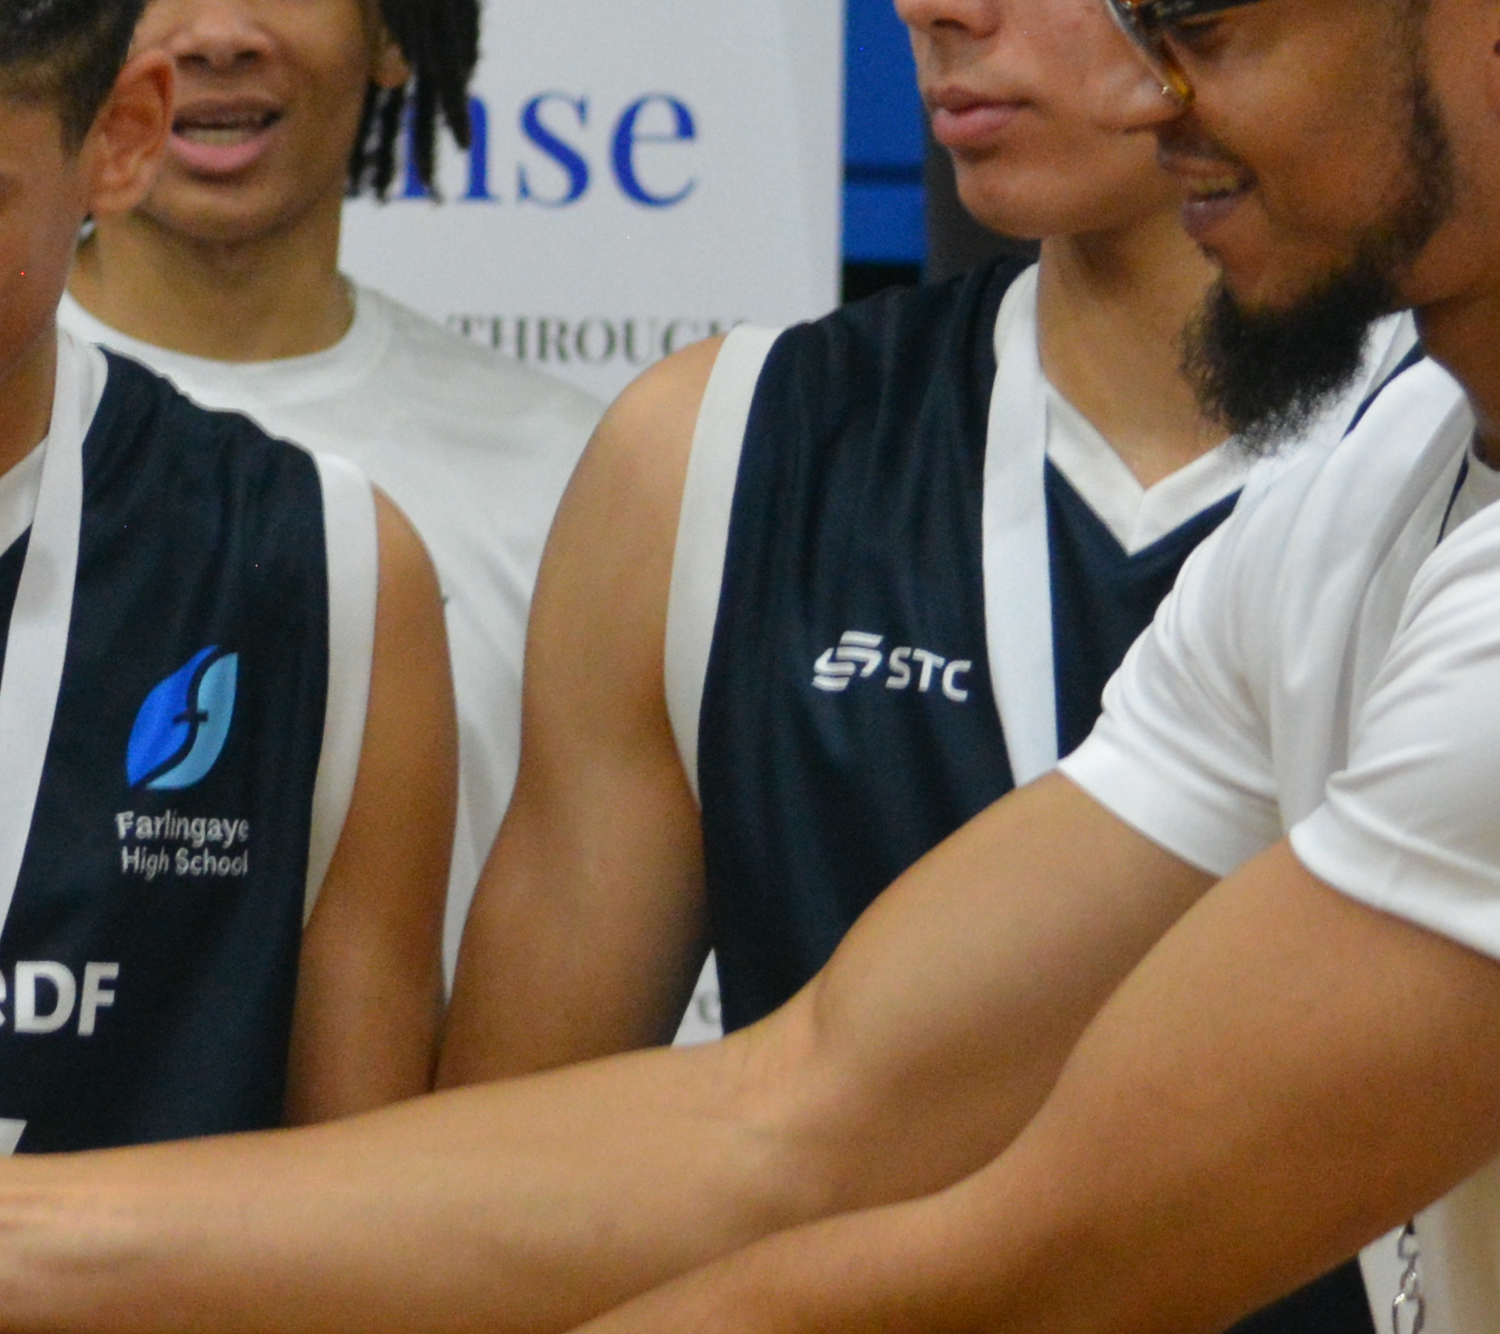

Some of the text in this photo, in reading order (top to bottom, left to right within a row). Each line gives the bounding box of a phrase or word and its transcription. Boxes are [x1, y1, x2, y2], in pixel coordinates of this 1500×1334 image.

[885, 646, 972, 703] STC
[115, 808, 250, 850] Farlingaye
[120, 845, 250, 882] High School
